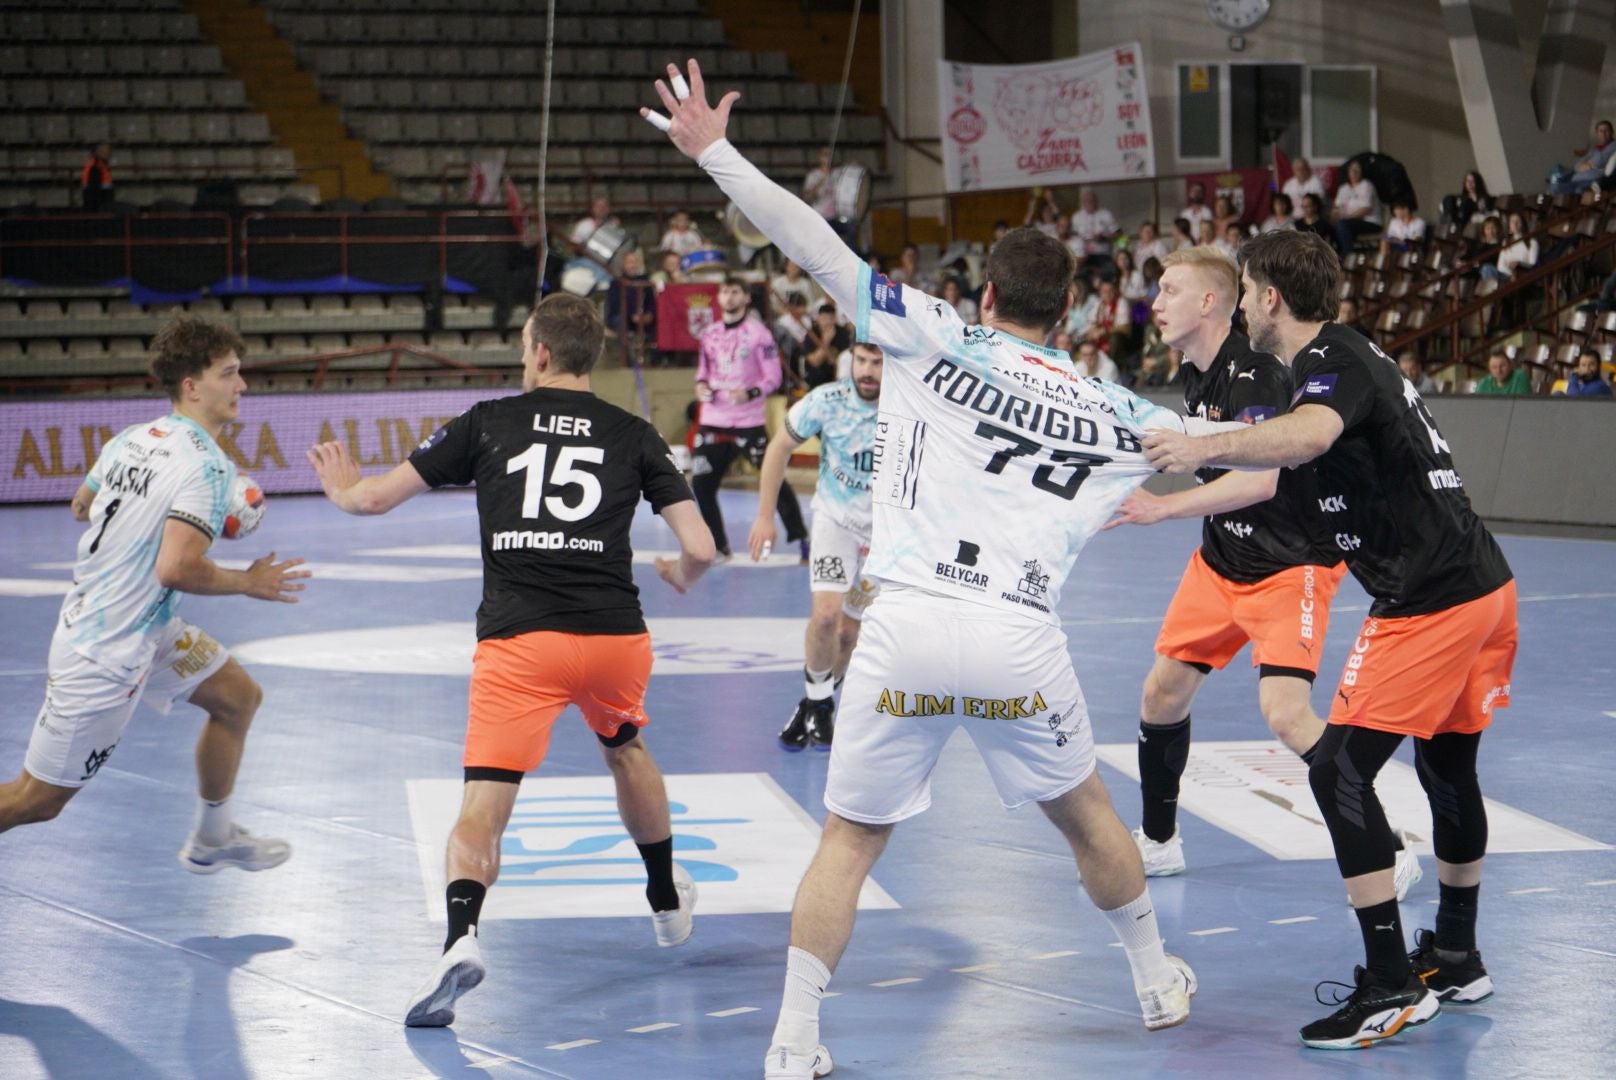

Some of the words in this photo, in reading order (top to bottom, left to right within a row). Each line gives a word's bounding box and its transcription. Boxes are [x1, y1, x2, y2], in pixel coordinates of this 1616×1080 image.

[923, 358, 1099, 446] RODRIGO
[533, 413, 592, 437] LIER
[506, 443, 604, 522] 15
[936, 562, 989, 588] BELYCAR
[1001, 592, 1020, 604] PASO
[1301, 598, 1314, 639] BBC
[1344, 635, 1370, 686] BBC
